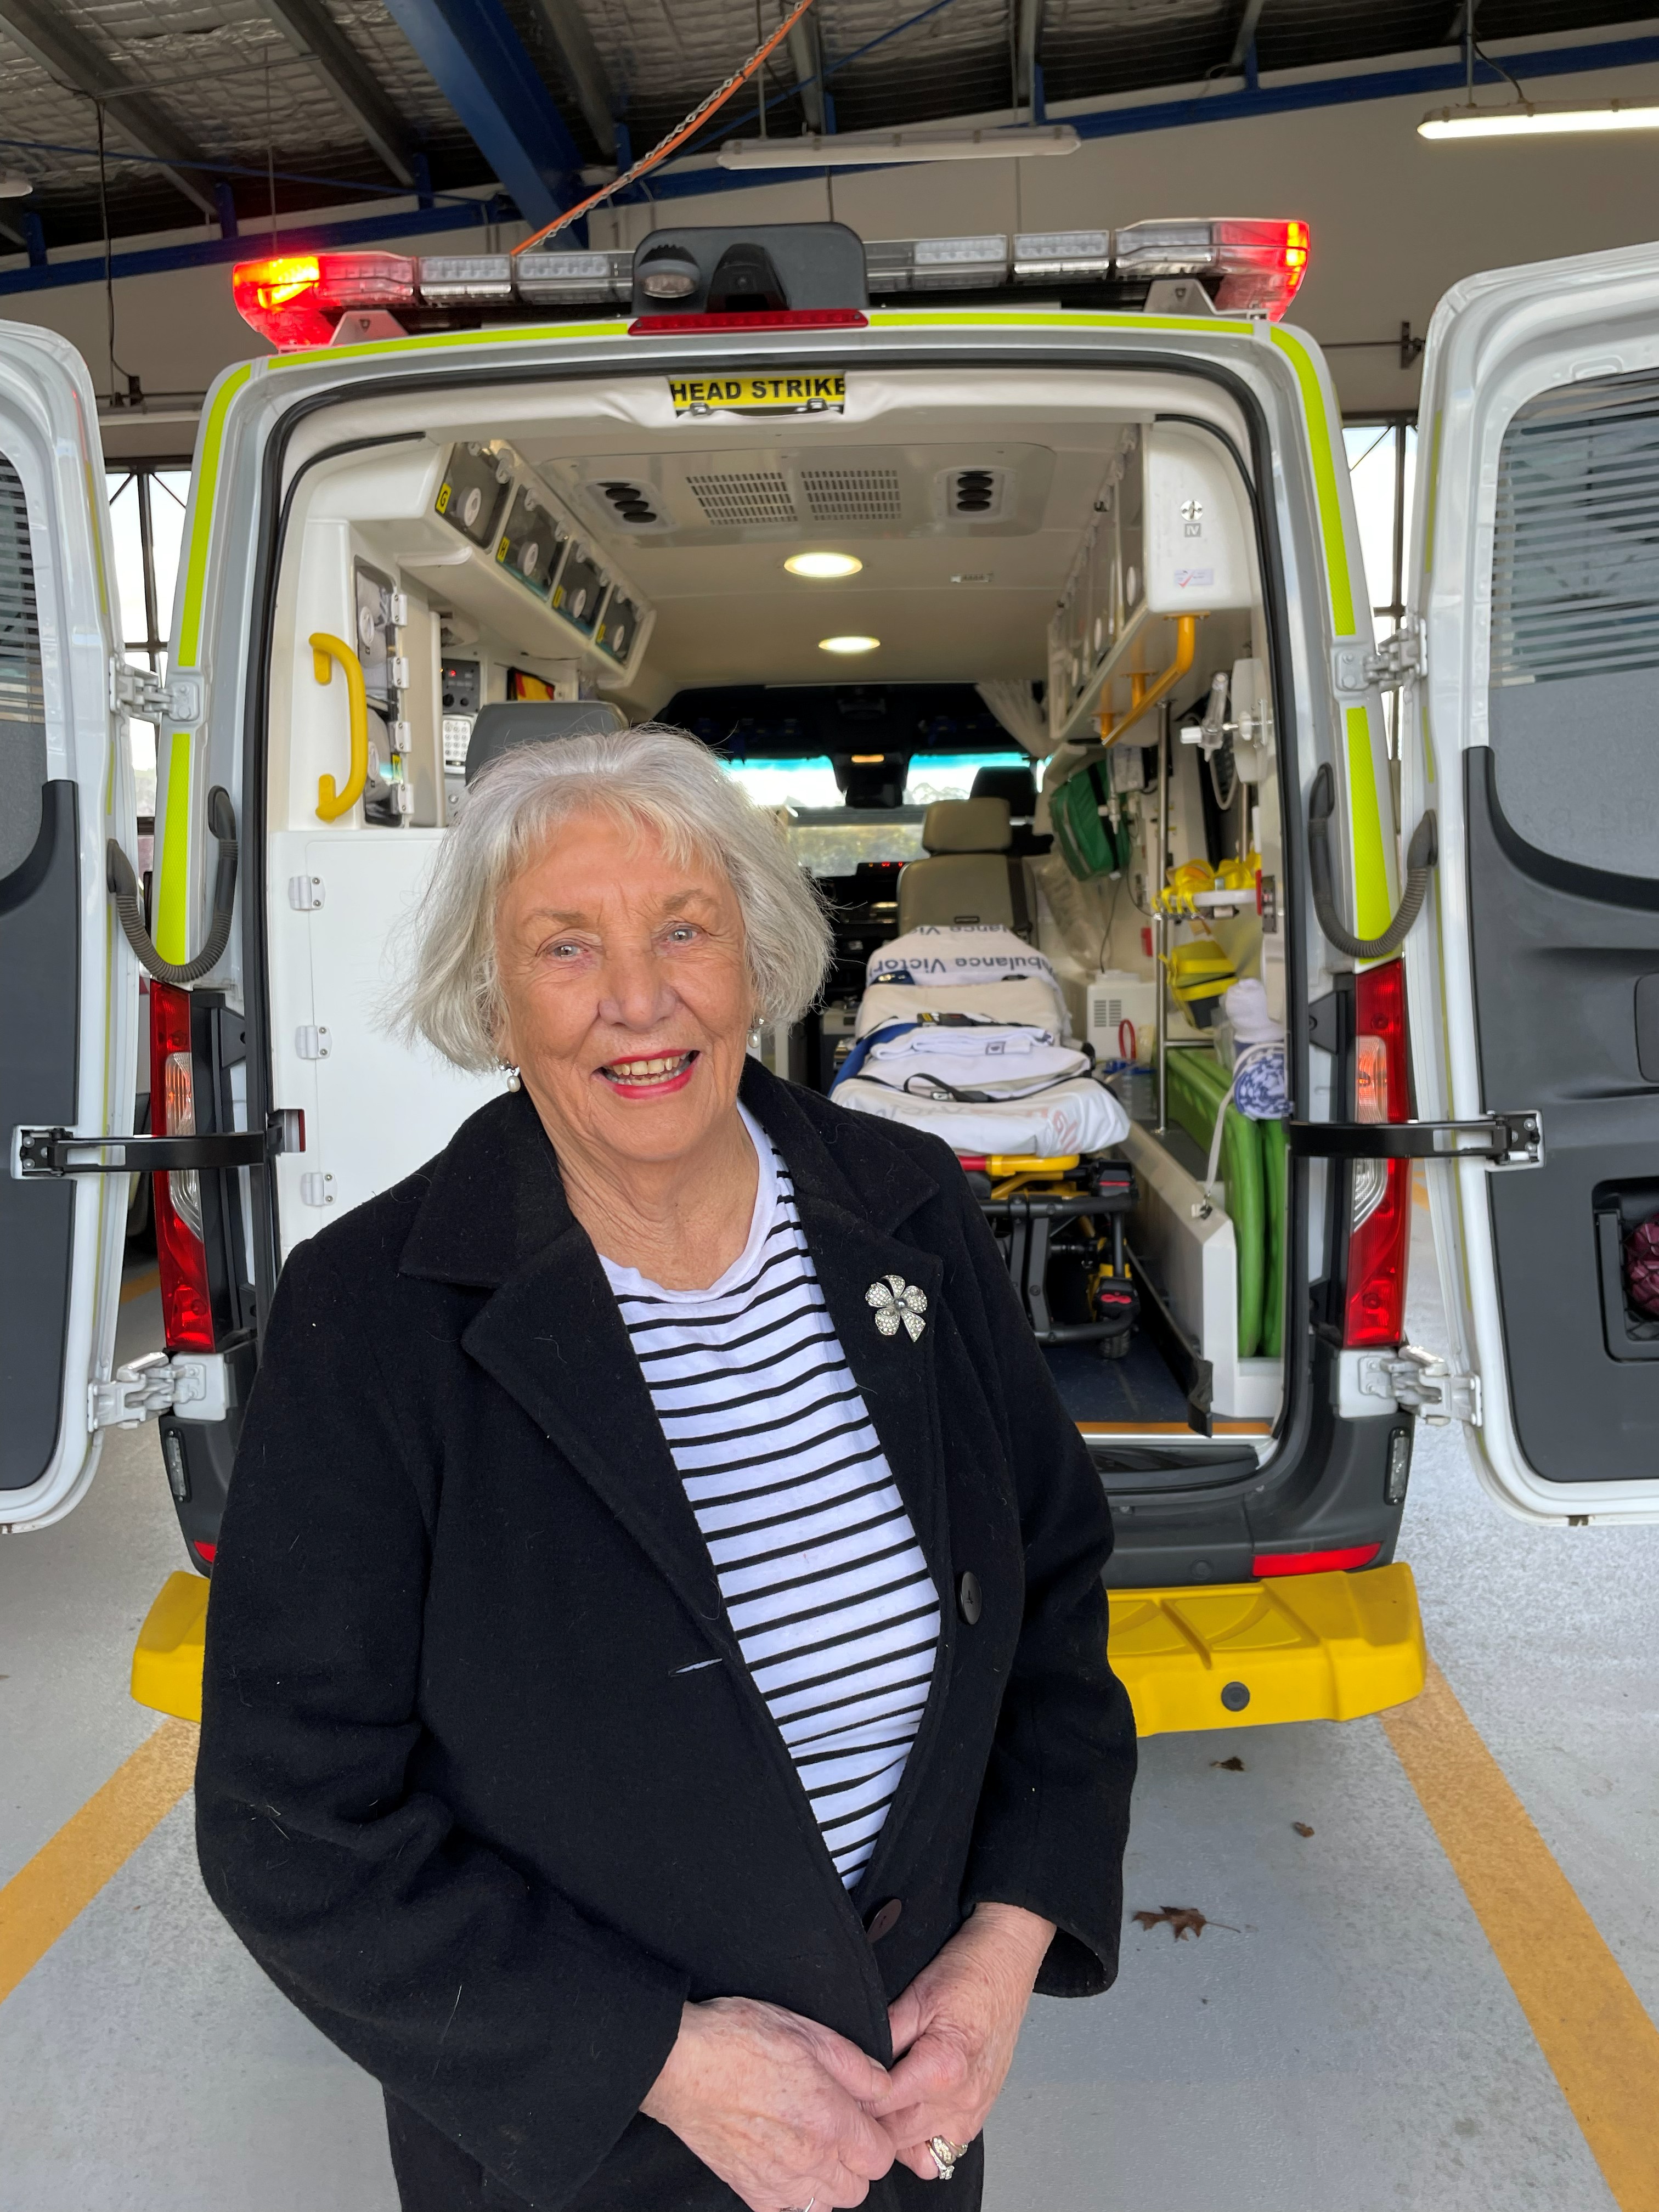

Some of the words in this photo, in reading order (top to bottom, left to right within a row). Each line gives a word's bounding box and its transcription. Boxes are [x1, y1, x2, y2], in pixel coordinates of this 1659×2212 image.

[670, 382, 742, 402] HEAD
[752, 377, 845, 399] STRIKE
[439, 490, 449, 507] G
